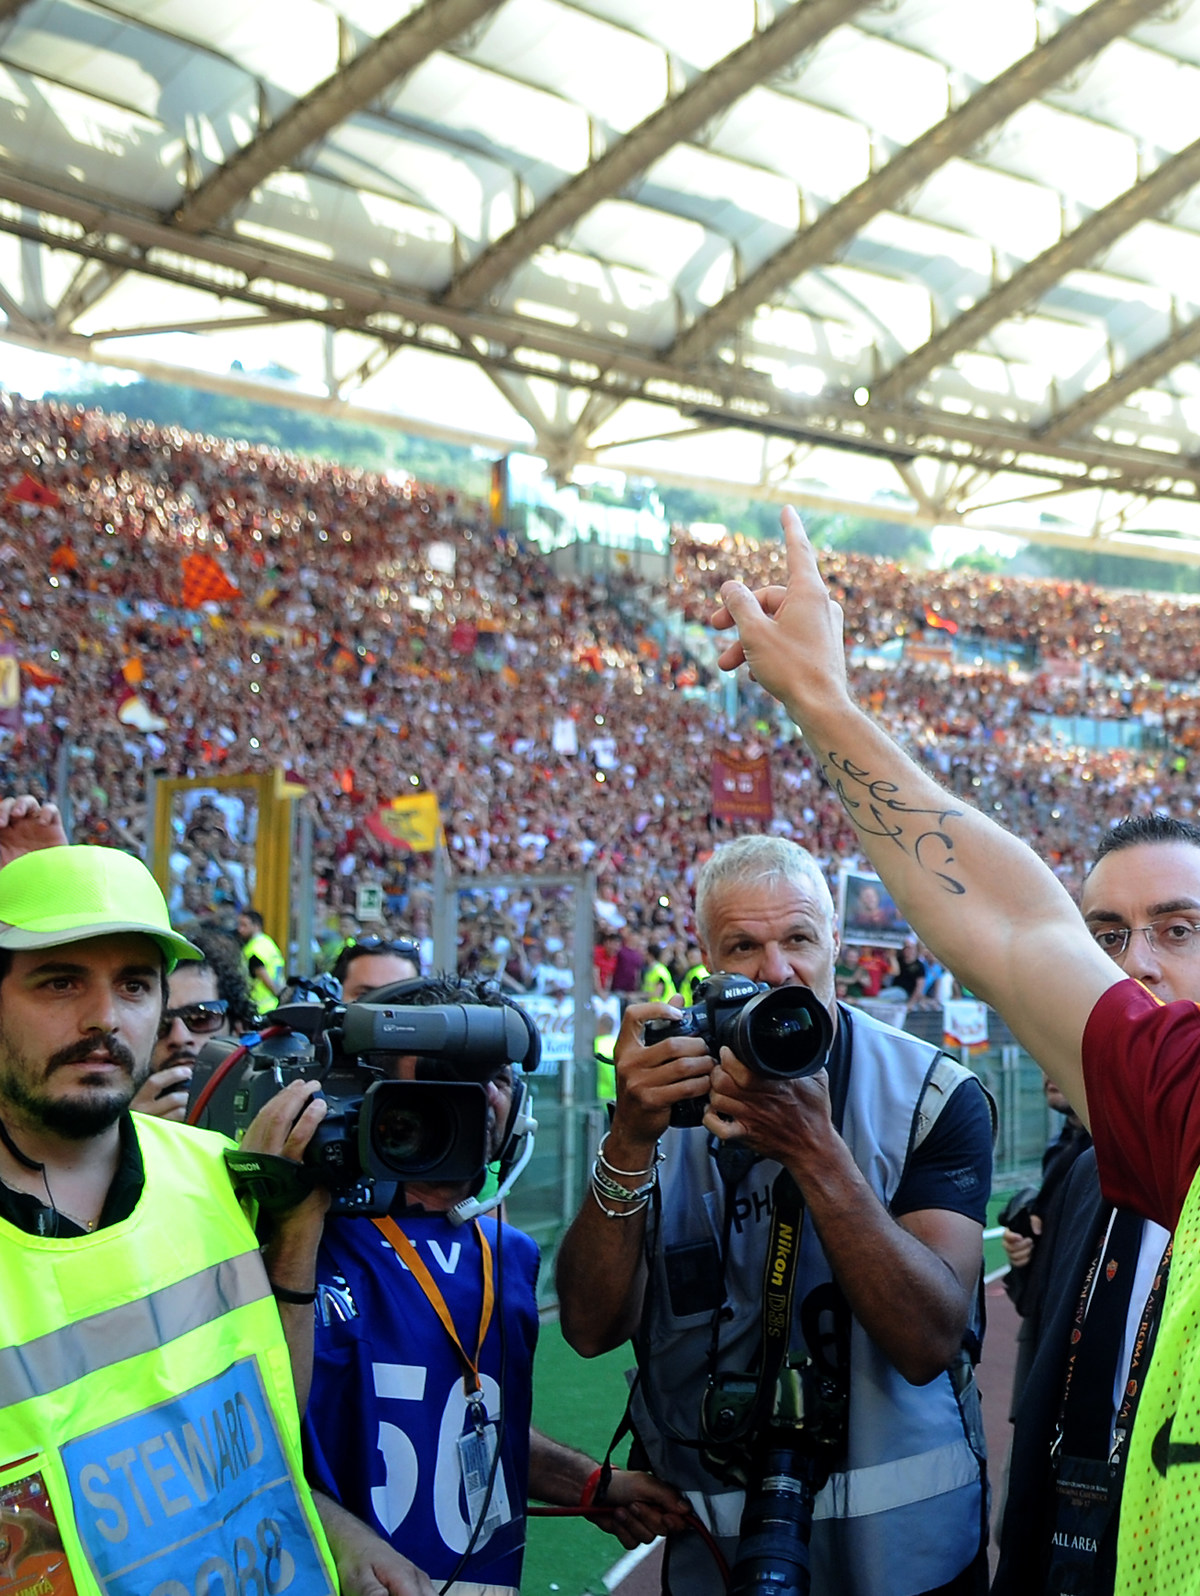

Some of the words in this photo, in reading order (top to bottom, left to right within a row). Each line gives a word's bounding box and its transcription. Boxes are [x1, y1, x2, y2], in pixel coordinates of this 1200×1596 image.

[724, 986, 754, 999] Nikon
[770, 1222, 794, 1287] Nikon
[79, 1391, 264, 1544] STEWARD
[1051, 1531, 1070, 1548] ALL
[1070, 1535, 1098, 1553] AREA
